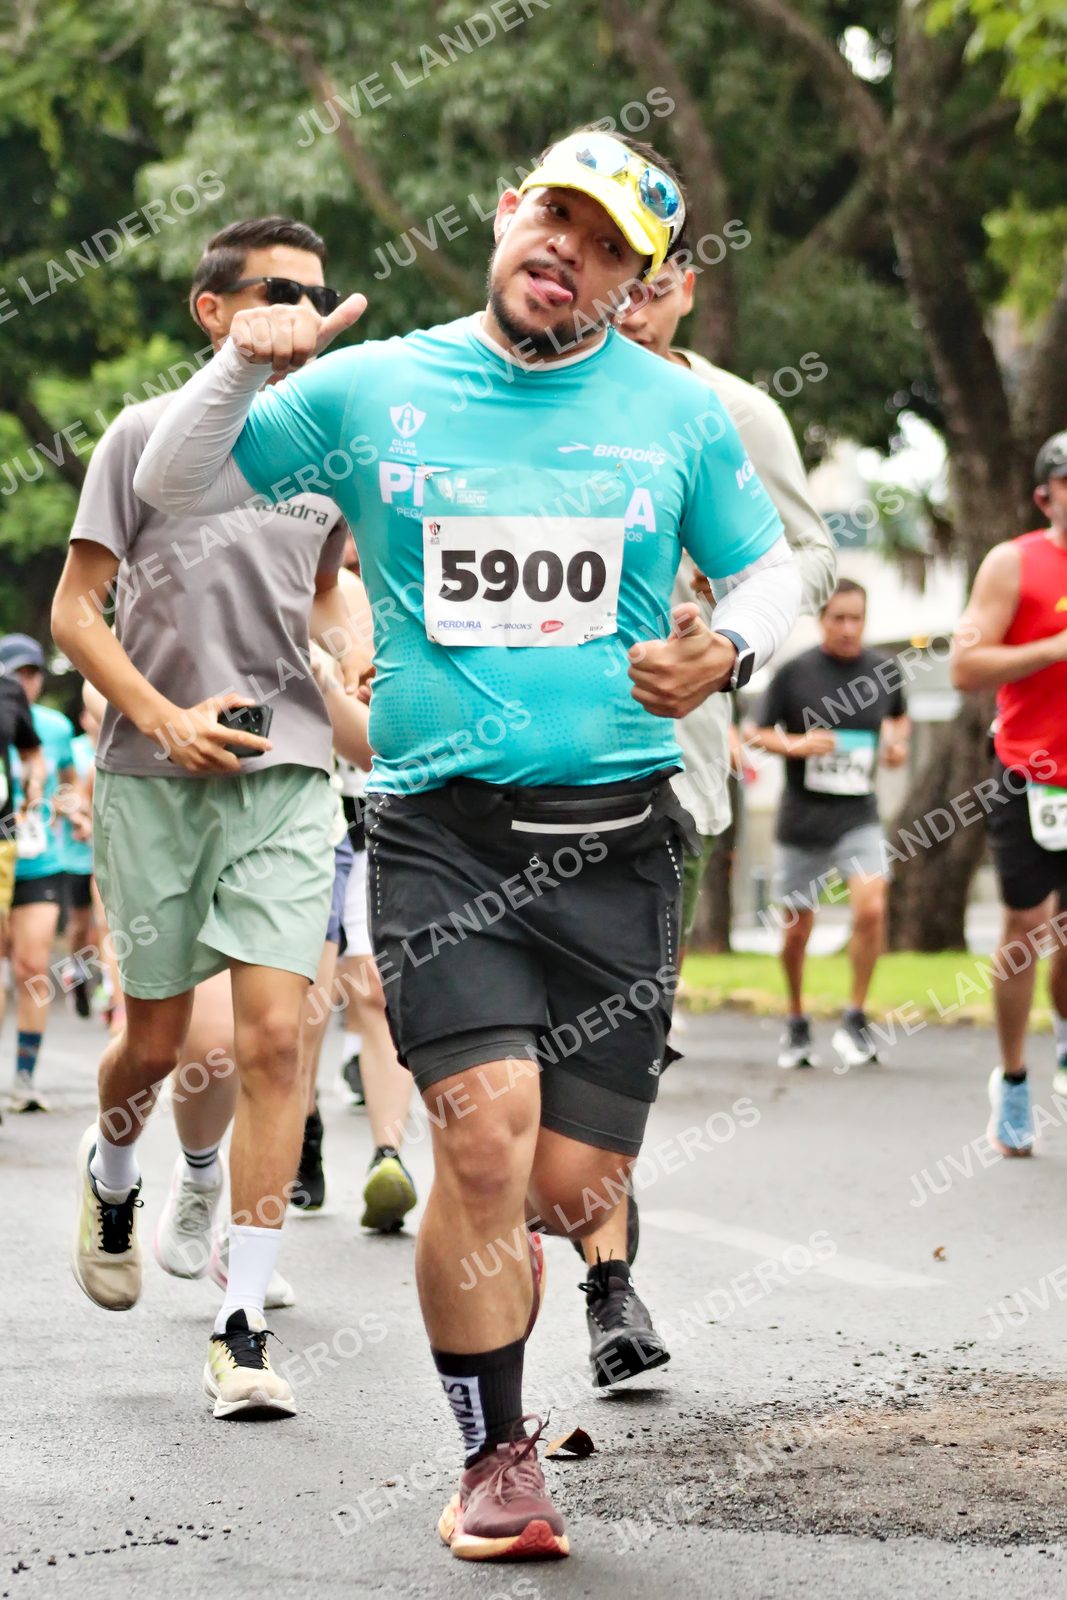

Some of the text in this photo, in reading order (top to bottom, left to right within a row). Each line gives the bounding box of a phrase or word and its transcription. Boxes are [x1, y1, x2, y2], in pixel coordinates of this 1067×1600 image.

[593, 444, 666, 465] BROOKS
[439, 549, 607, 603] 5900
[437, 620, 482, 630] PERDURA
